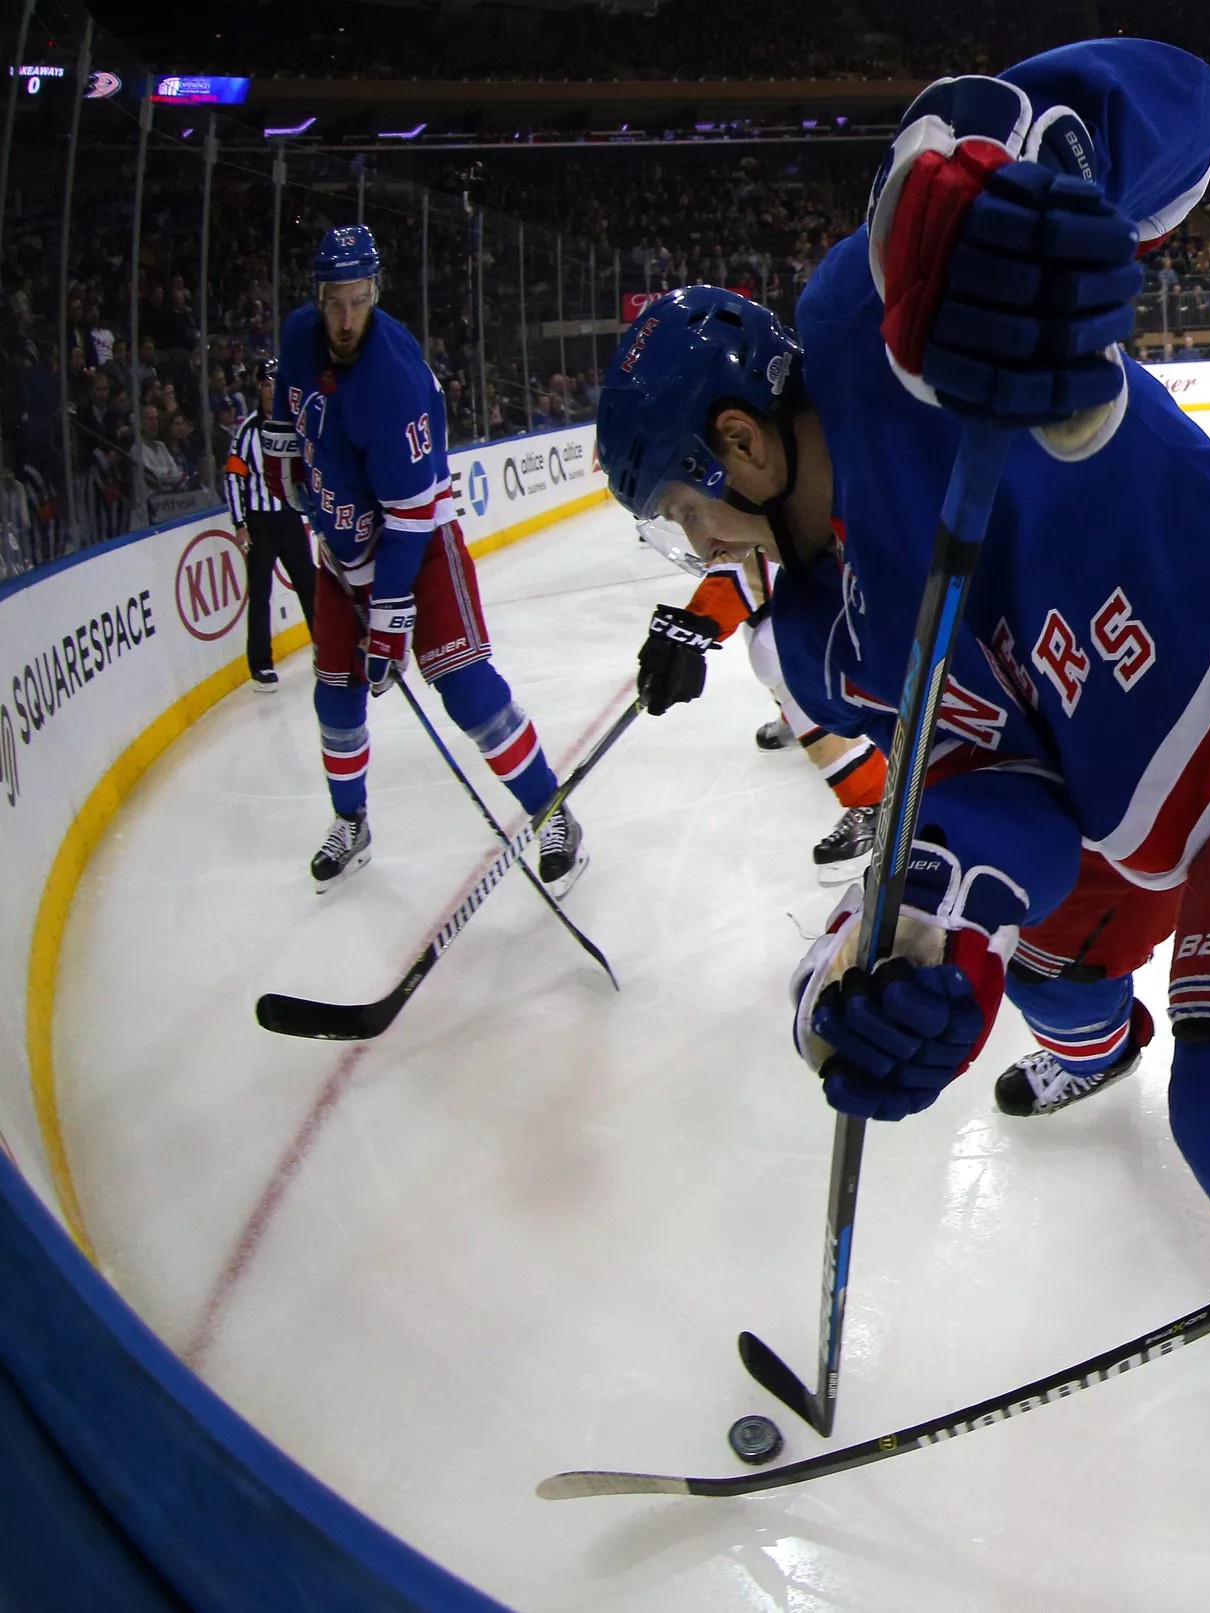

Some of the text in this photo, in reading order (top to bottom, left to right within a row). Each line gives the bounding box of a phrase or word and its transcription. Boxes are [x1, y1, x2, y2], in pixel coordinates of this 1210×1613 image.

[10, 66, 64, 77] KEAWAYS
[405, 412, 433, 464] 13
[185, 550, 241, 623] KIA
[651, 616, 713, 649] CCM
[13, 590, 156, 745] SQUARESPACE
